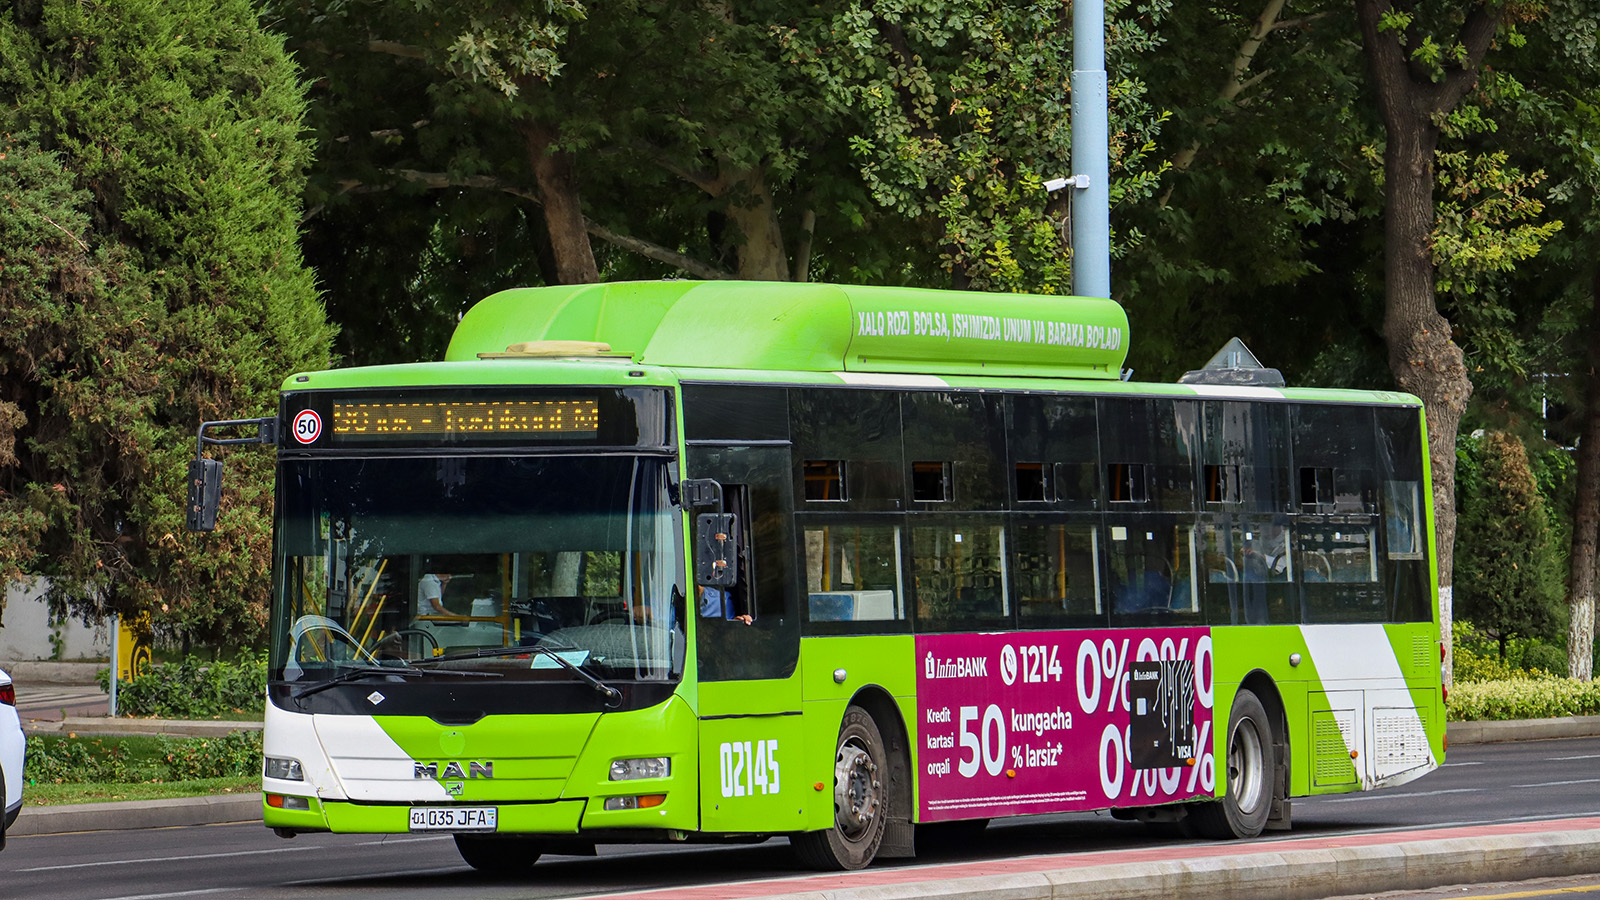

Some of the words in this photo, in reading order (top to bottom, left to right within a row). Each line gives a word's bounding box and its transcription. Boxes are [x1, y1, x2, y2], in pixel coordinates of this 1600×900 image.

[858, 311, 885, 337] XALQ
[887, 311, 910, 336] ROZI
[952, 313, 1001, 341] ISHIMIZDA
[1003, 317, 1031, 343] UNUM
[1032, 320, 1046, 344] VA
[1047, 321, 1084, 347] BARAKA
[298, 419, 316, 434] 50
[936, 657, 988, 678] InfinBANK
[1020, 645, 1062, 683] 1214
[926, 707, 951, 723] Kredit
[1011, 706, 1072, 736] kungacha
[927, 732, 954, 749] kartasi
[958, 704, 1006, 778] 50
[1012, 745, 1024, 768] %
[414, 761, 493, 779] MAN
[720, 739, 780, 798] 02145
[927, 758, 951, 778] orqali
[413, 812, 426, 824] 01
[429, 811, 454, 826] 035
[458, 811, 487, 826] JFA
